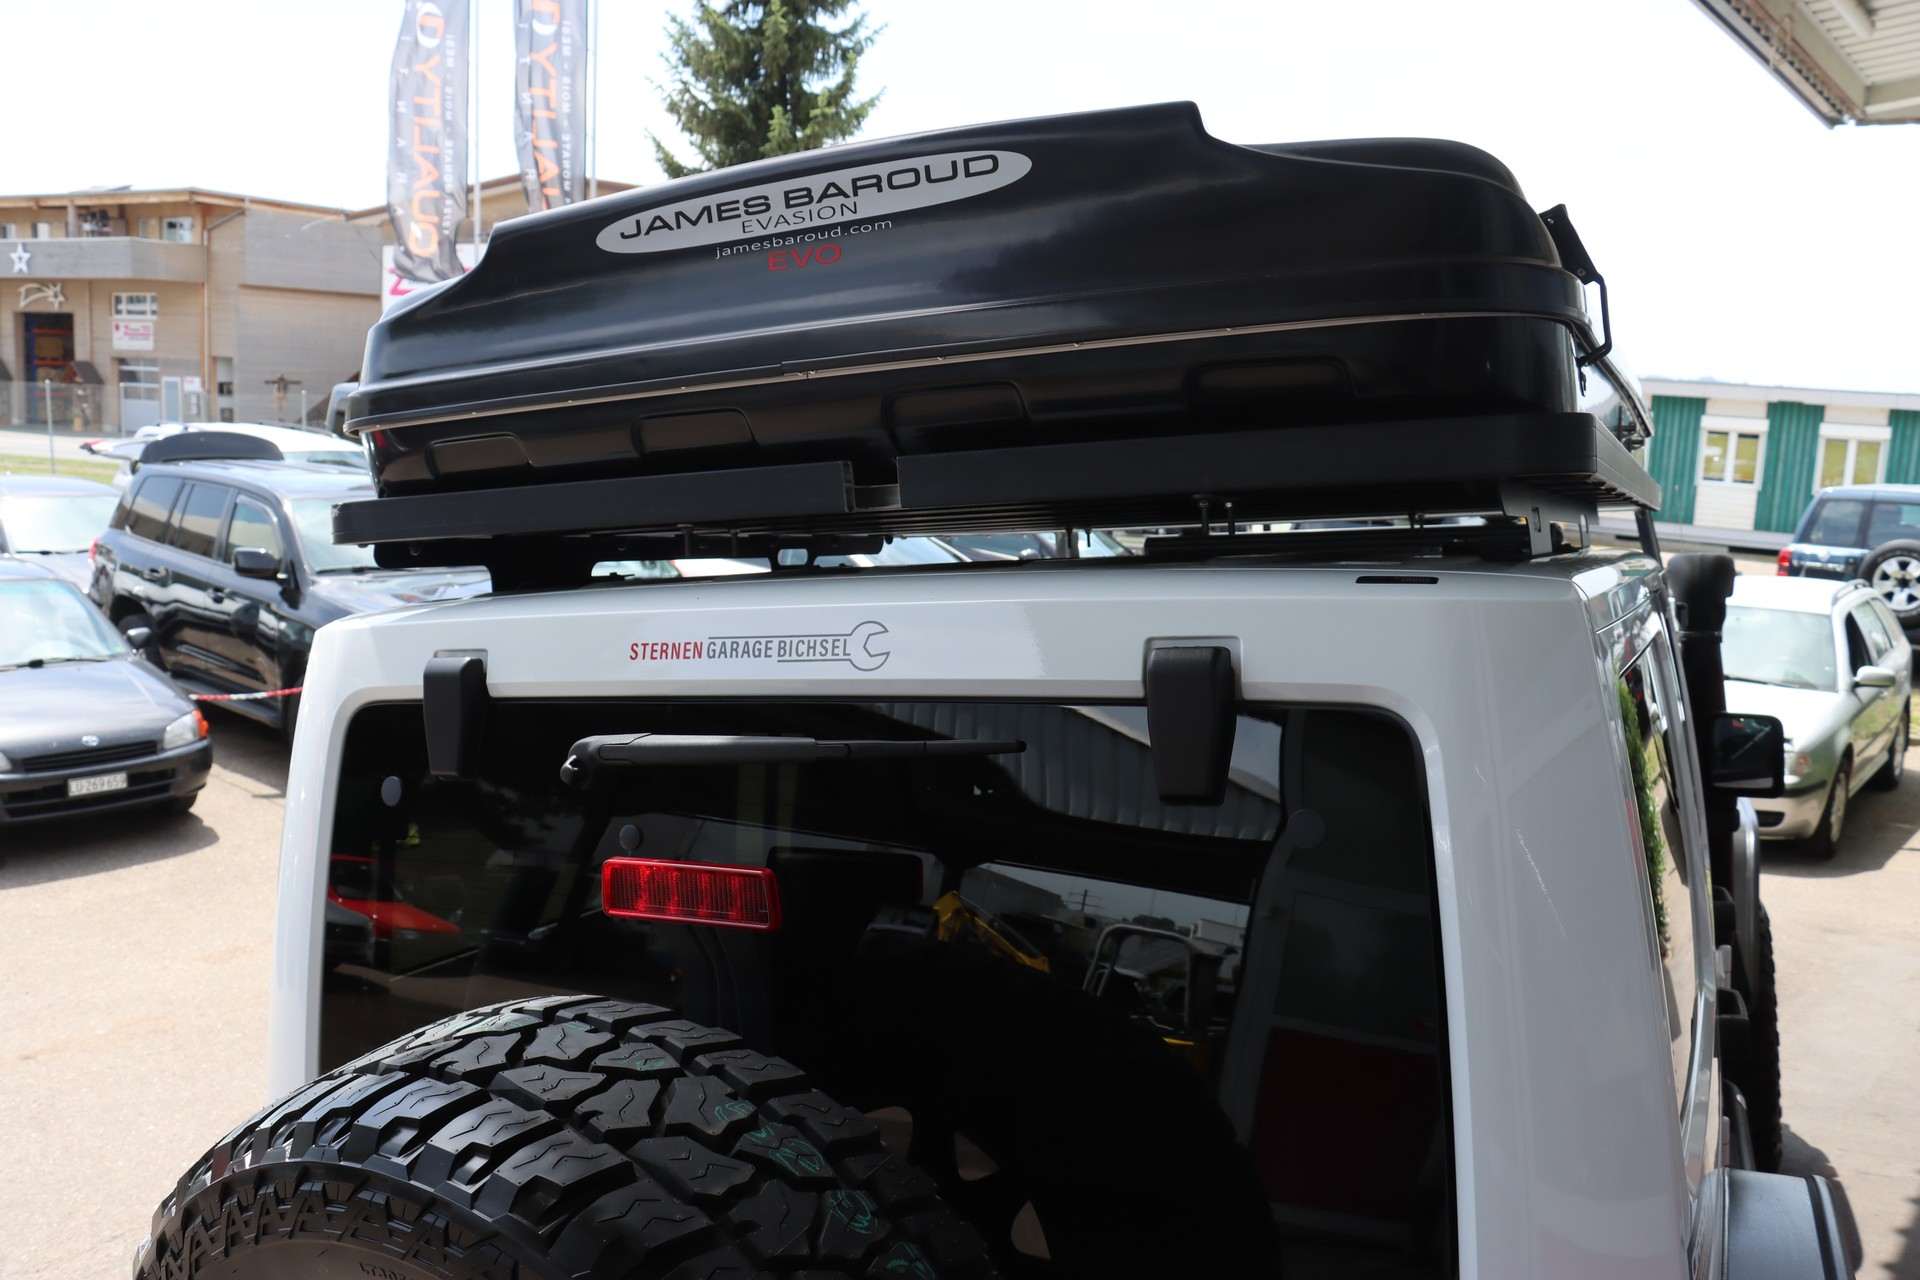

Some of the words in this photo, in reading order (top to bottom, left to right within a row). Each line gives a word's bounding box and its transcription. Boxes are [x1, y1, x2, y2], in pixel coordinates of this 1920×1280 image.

[619, 190, 772, 241] JAMES
[784, 153, 1000, 210] BAROUD
[741, 200, 859, 234] EVASION
[715, 218, 892, 260] jamesbaroud.com
[768, 243, 843, 272] EVO
[777, 638, 851, 658] BICHSEL
